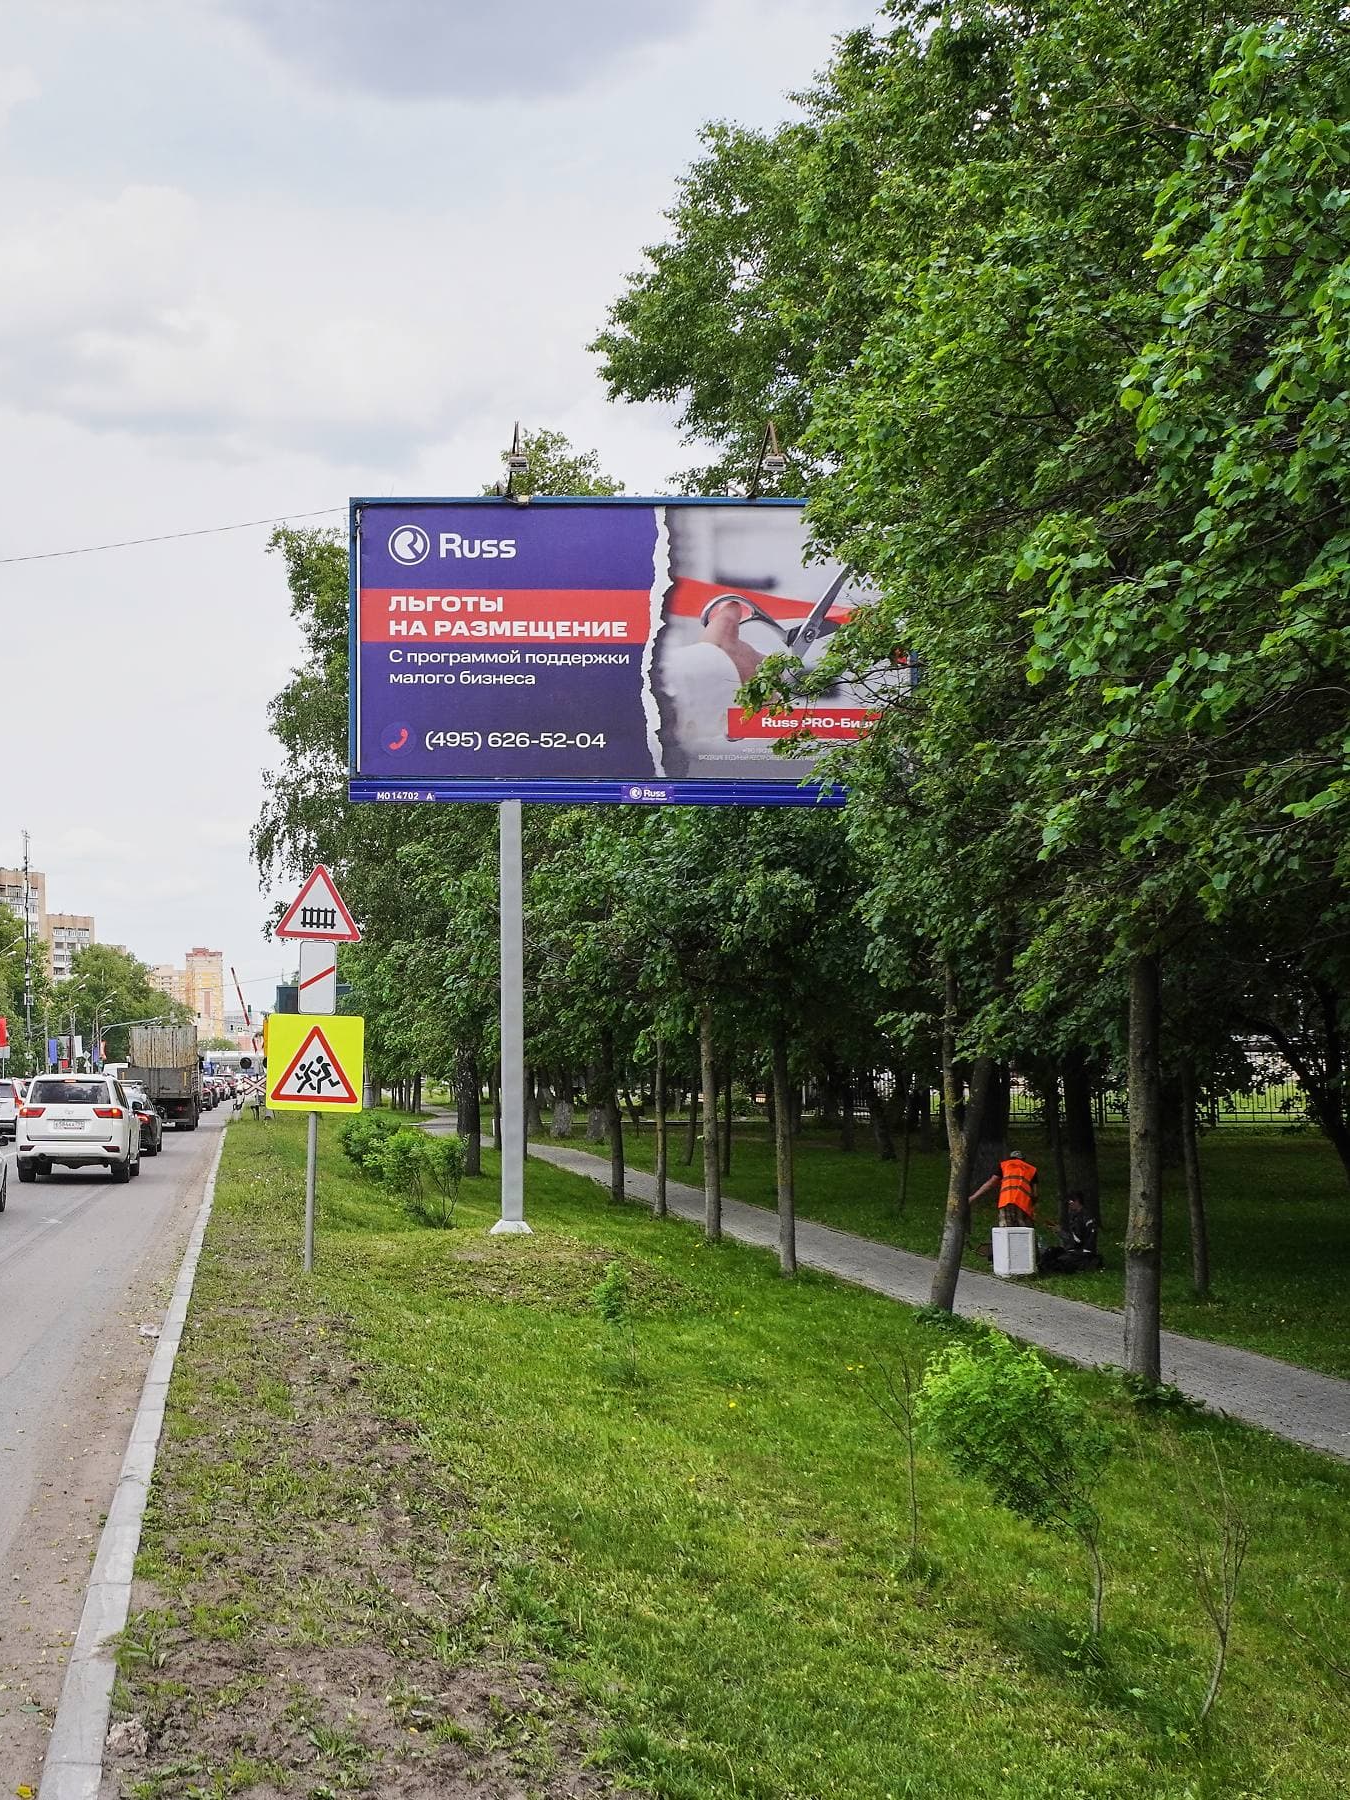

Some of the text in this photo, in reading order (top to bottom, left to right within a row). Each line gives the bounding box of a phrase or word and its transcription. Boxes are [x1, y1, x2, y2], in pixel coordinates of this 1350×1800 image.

[439, 532, 517, 559] Russ
[388, 595, 504, 613] ЛЬГОТЫ
[389, 620, 628, 640] НА РАЗМЕЩЕНИЕ
[389, 649, 630, 667] С программой поддержки
[389, 670, 536, 685] малого бизнеса
[761, 717, 799, 728] Russ
[425, 730, 607, 752] (495) 626-52-04
[643, 789, 666, 798] Russ
